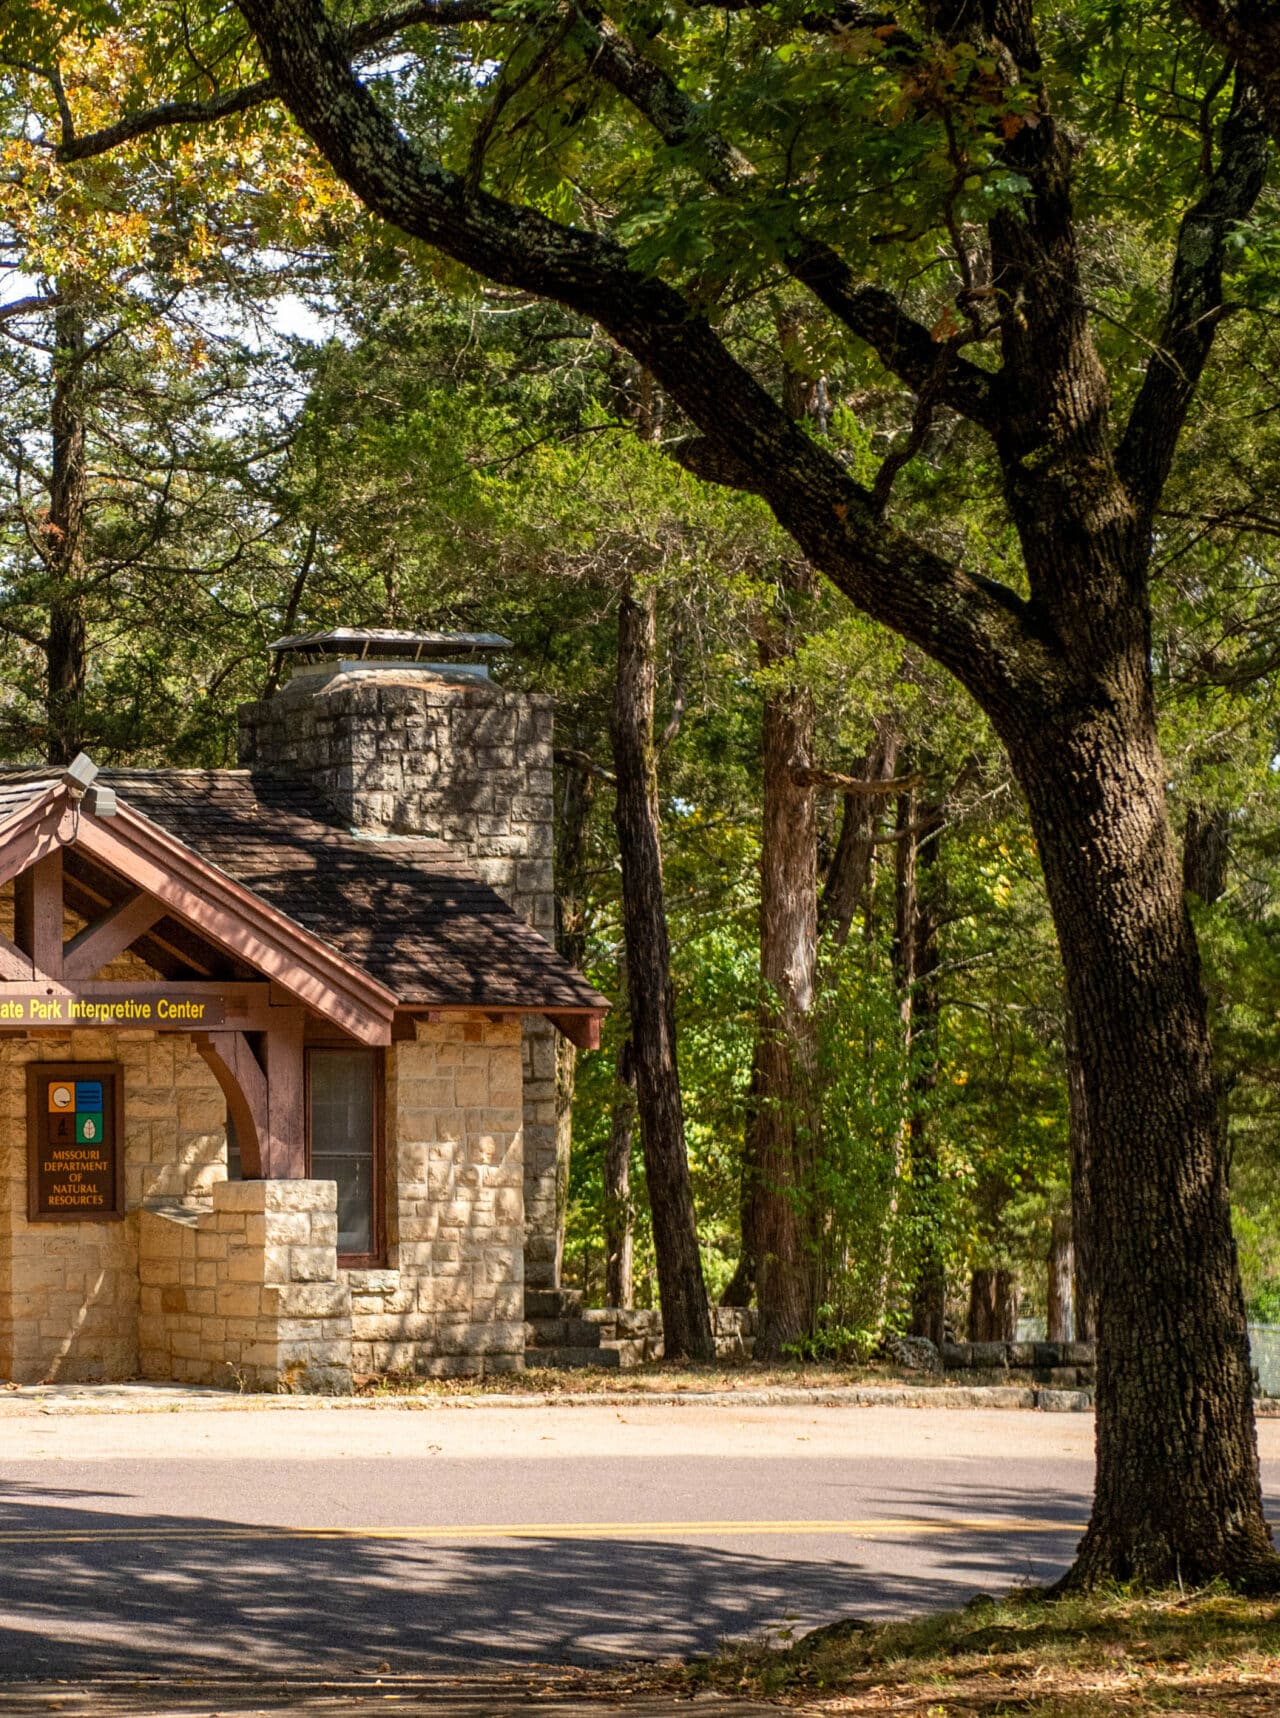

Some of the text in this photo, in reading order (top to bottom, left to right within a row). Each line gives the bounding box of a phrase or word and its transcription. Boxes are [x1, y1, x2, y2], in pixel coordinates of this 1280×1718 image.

[29, 998, 62, 1019] Park
[67, 999, 152, 1022] Interpretive
[156, 998, 206, 1020] Center
[52, 1150, 100, 1160] MISSOURI
[44, 1161, 108, 1171] DEPARTMENT
[68, 1173, 82, 1182] OF
[52, 1184, 98, 1193] NATURAL
[48, 1195, 104, 1205] RESOURCES
